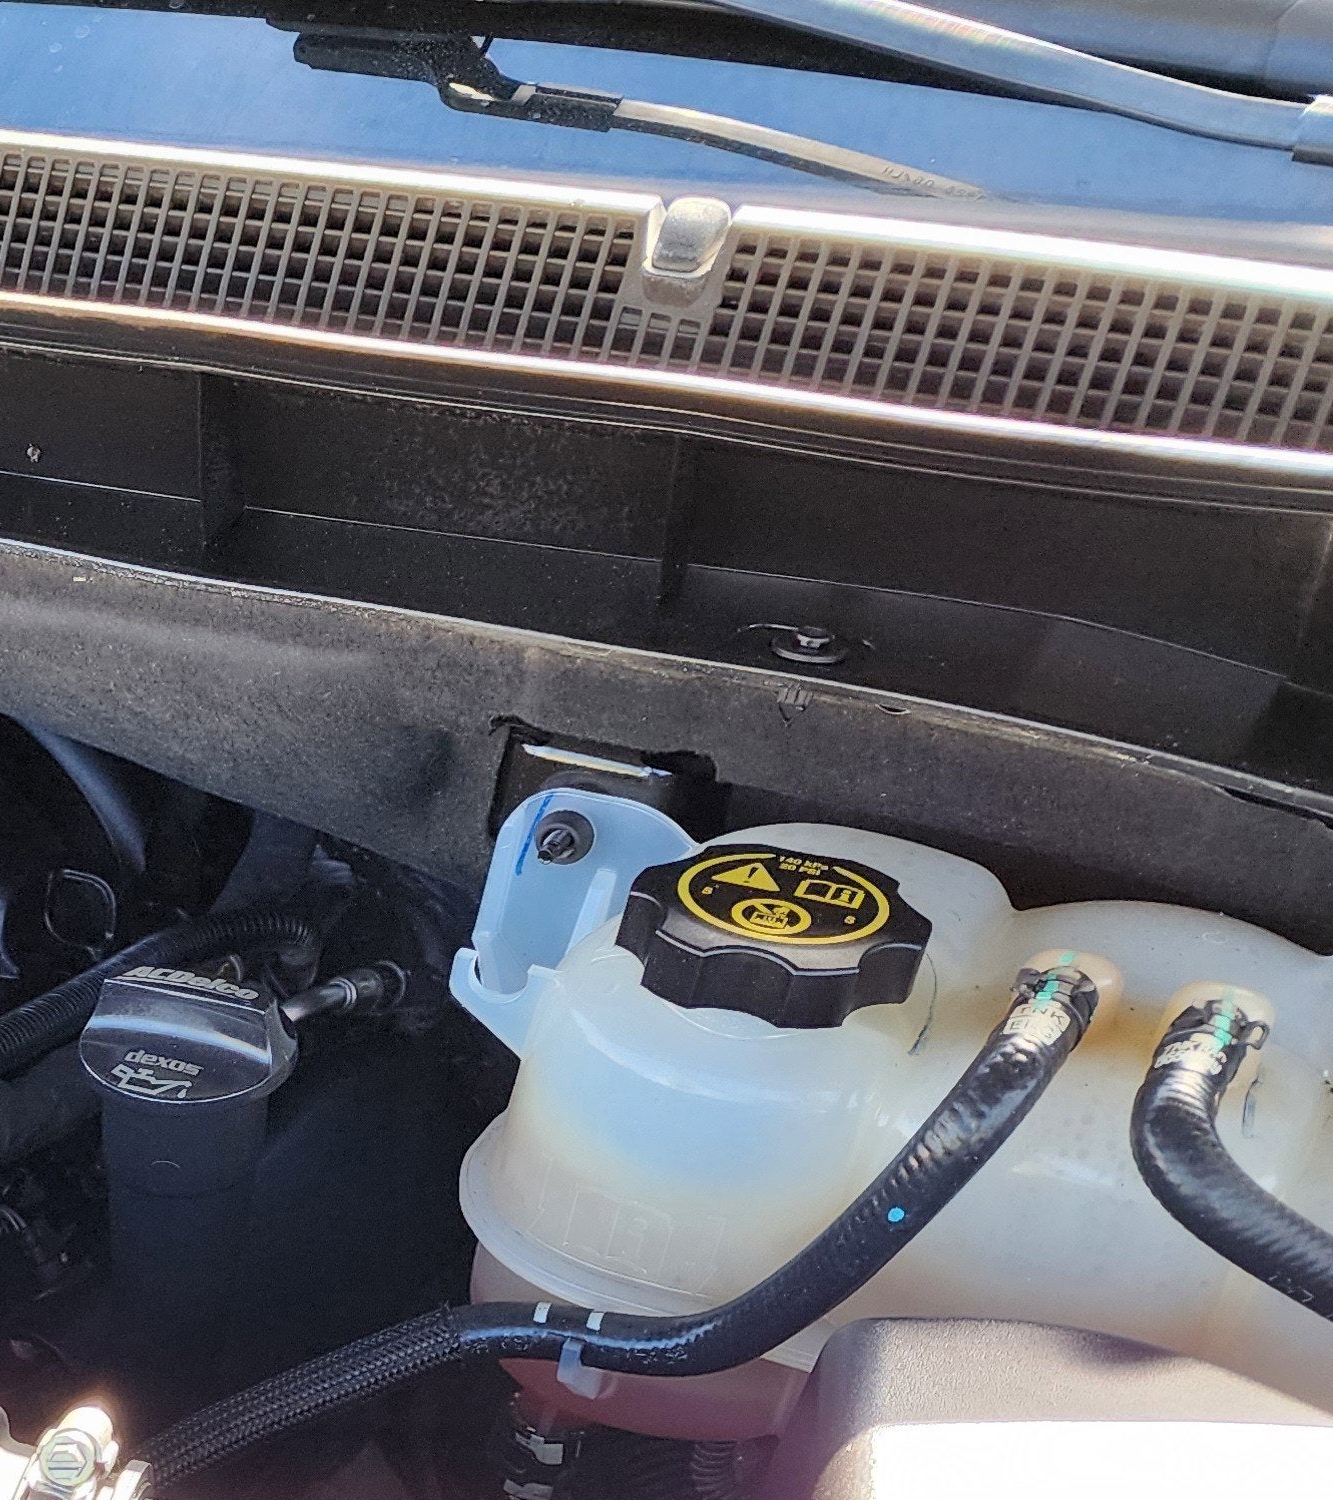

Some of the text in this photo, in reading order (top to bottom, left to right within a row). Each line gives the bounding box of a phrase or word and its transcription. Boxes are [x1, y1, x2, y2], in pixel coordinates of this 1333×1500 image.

[778, 863, 821, 876] 20 PSI
[779, 856, 803, 866] 140
[122, 966, 259, 1000] ACDelco
[124, 1050, 204, 1076] dexos
